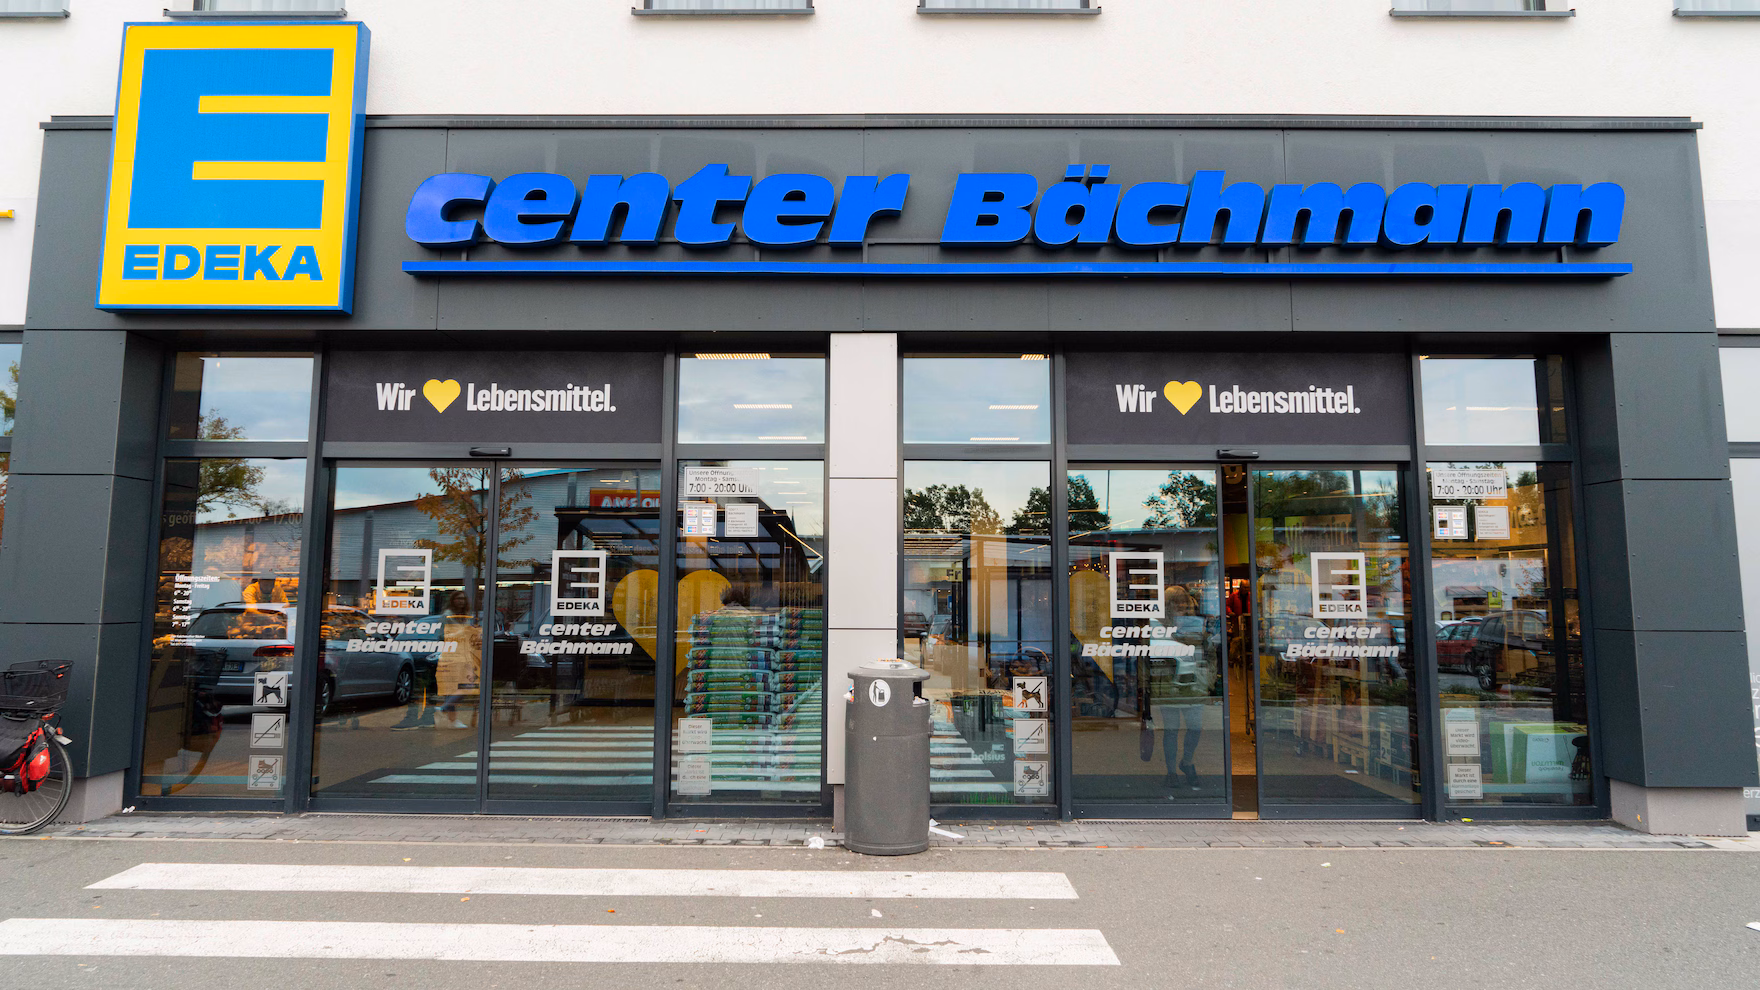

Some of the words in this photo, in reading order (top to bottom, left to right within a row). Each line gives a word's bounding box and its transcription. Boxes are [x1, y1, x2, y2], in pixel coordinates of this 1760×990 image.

[405, 164, 910, 248] center
[940, 164, 1625, 248] Bächmann
[122, 244, 323, 281] EDEKA
[376, 383, 416, 410] Wir
[466, 383, 616, 412] Lebensmittel.
[1116, 384, 1157, 412] Wir
[1209, 385, 1361, 414] Lebensmittel.
[689, 483, 706, 493] 7:00
[714, 483, 736, 493] 20:00
[1437, 485, 1454, 495] 7:00
[1463, 485, 1484, 495] 20:00
[1486, 485, 1503, 495] Uhr
[382, 600, 424, 609] EDEKA
[557, 602, 600, 610] EDEKA
[1116, 604, 1160, 612] EDEKA
[1319, 604, 1362, 613] EDEKA
[365, 620, 442, 634] center
[539, 622, 617, 636] center
[1100, 625, 1177, 638] center
[1304, 625, 1381, 639] center
[346, 637, 458, 652] Bächmann
[520, 639, 633, 654] Bächmann
[1082, 642, 1195, 657] Bächmann
[1286, 642, 1399, 657] Bächmann
[971, 751, 1005, 761] bolsius
